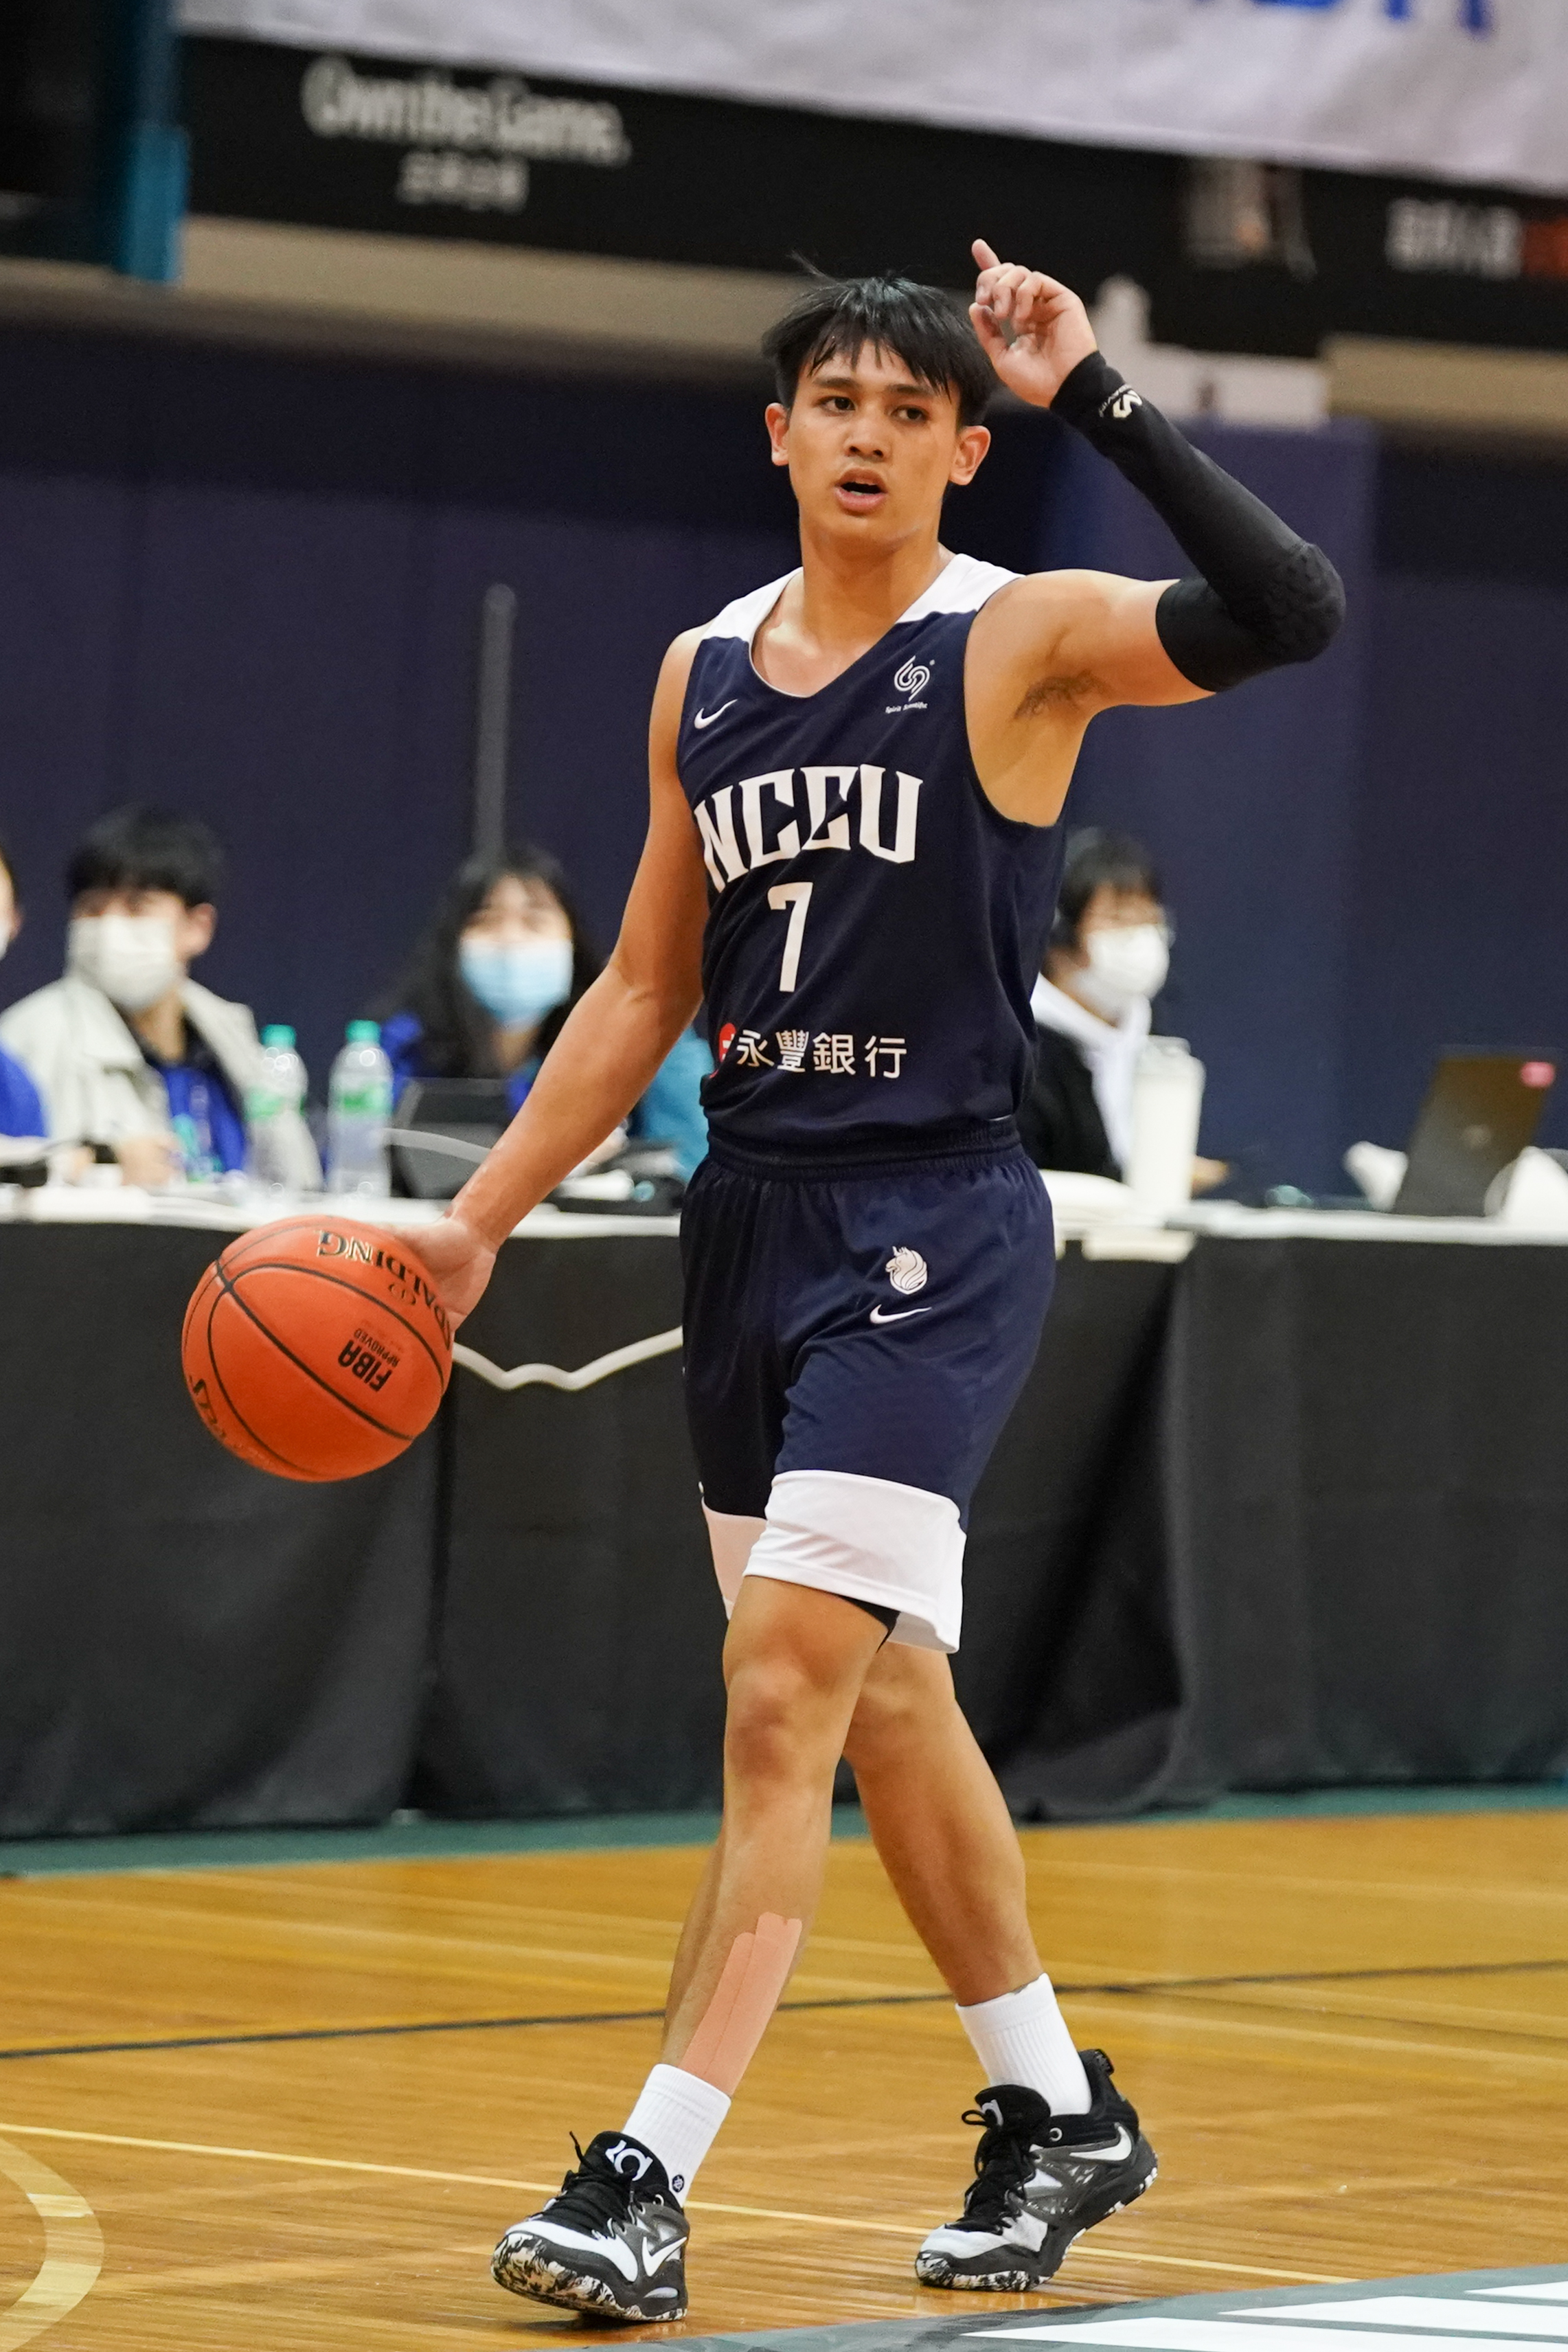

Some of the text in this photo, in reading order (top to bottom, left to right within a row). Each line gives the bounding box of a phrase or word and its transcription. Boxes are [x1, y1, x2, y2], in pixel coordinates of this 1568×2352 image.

[694, 764, 923, 893] NCCU
[767, 882, 813, 992] 7
[736, 1030, 907, 1078] 永豐銀行
[338, 1339, 392, 1392] FIBA
[354, 1328, 400, 1368] APPROVED
